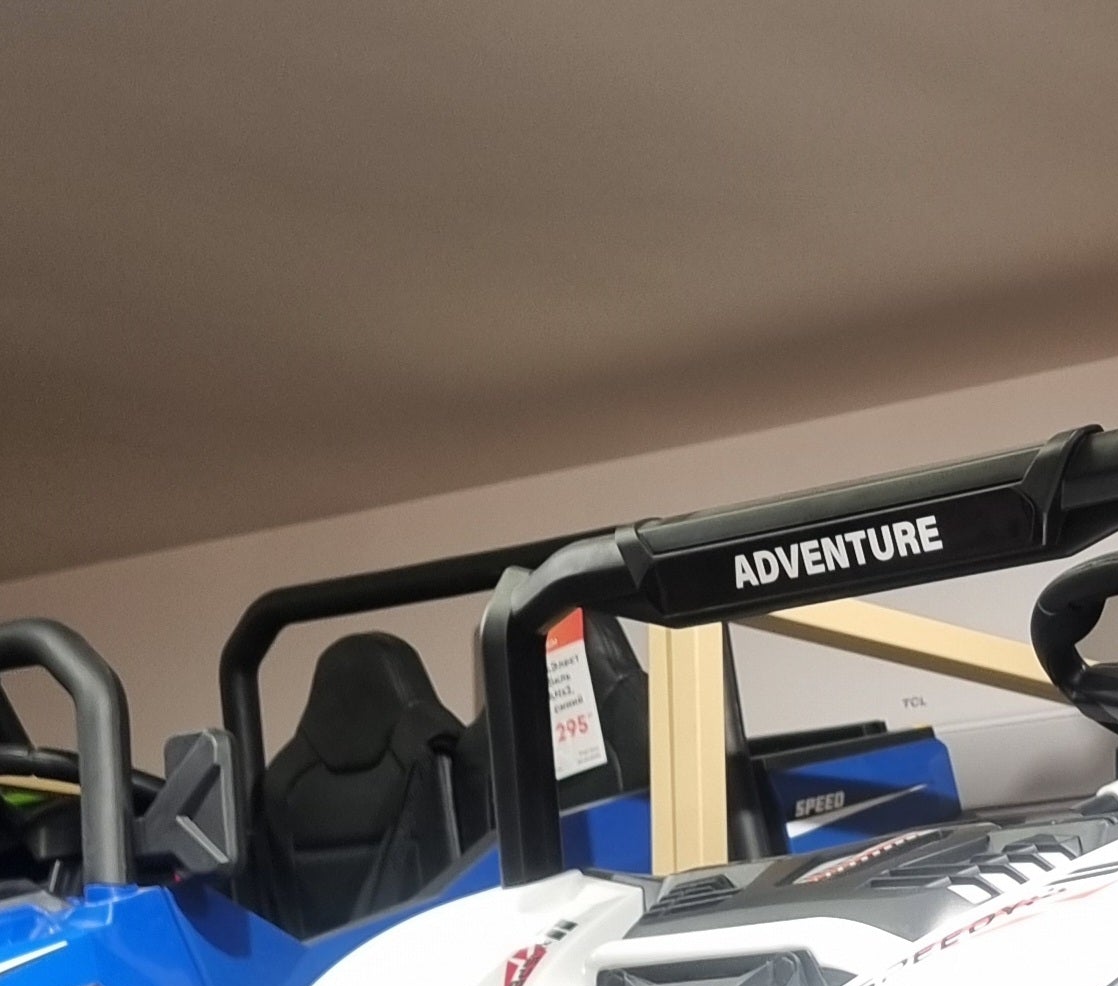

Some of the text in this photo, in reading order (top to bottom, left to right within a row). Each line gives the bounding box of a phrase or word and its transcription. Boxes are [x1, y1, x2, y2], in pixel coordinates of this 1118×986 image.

[734, 515, 943, 589] ADVENTURE
[902, 696, 926, 708] TCL
[556, 716, 588, 742] 295
[795, 790, 845, 818] SPEED
